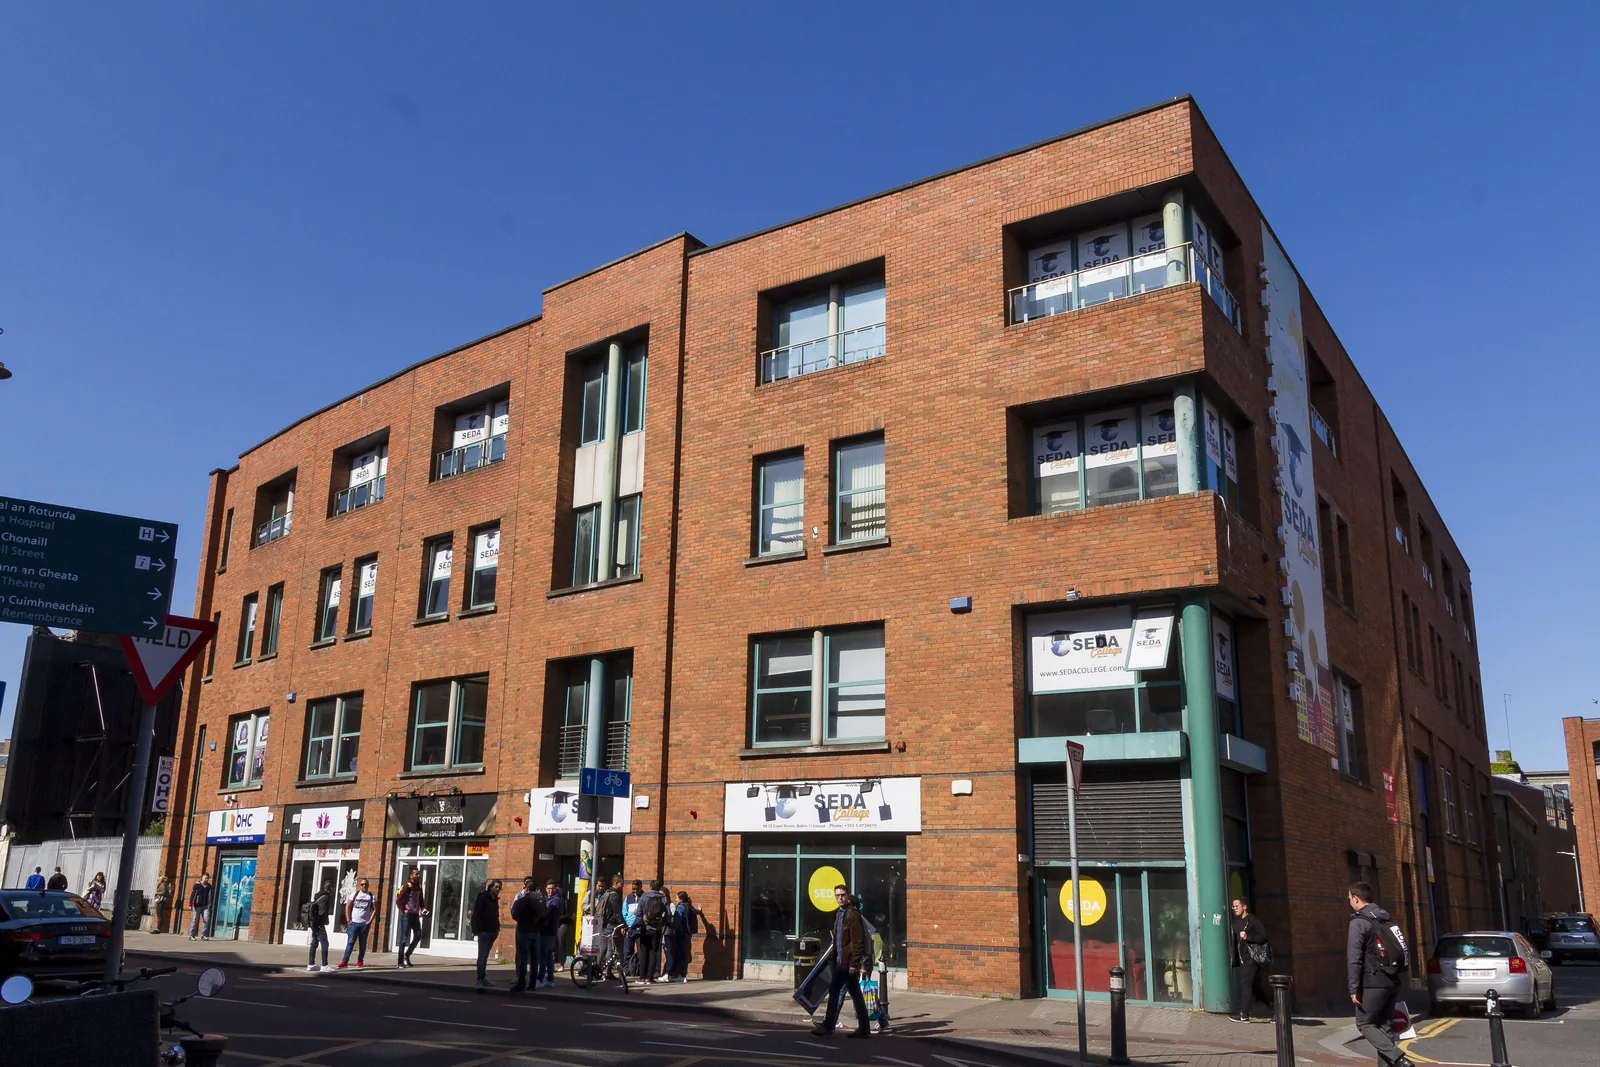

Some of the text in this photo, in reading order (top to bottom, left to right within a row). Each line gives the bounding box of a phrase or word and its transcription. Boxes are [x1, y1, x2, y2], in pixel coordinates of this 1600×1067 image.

[462, 429, 482, 440] SEDA
[1147, 432, 1176, 446] SED
[1090, 440, 1130, 455] SEDA
[1037, 451, 1073, 465] SEDA
[356, 470, 370, 479] SEDA
[11, 504, 25, 512] an
[29, 505, 76, 520] Rotunda
[9, 515, 55, 530] Hospital
[1284, 491, 1315, 550] SEDA
[1, 532, 48, 547] Chonaill
[11, 546, 45, 559] Street
[438, 561, 452, 570] SED
[21, 567, 35, 575] an
[38, 568, 79, 581] Gheata
[2, 576, 45, 590] Theatre
[364, 580, 376, 588] SED
[9, 595, 95, 614] Cuimhneacháin
[2, 608, 83, 625] Remembrance
[1136, 639, 1162, 647] SEDA
[1090, 645, 1123, 658] College
[1040, 665, 1126, 677] www.SEDACOLLEGE.com
[156, 773, 171, 810] OHC
[814, 793, 867, 810] SEDA
[236, 813, 253, 828] OHC
[441, 815, 464, 824] STUDIO
[833, 806, 870, 821] College
[814, 888, 834, 898] SED
[1067, 900, 1101, 911] SDA
